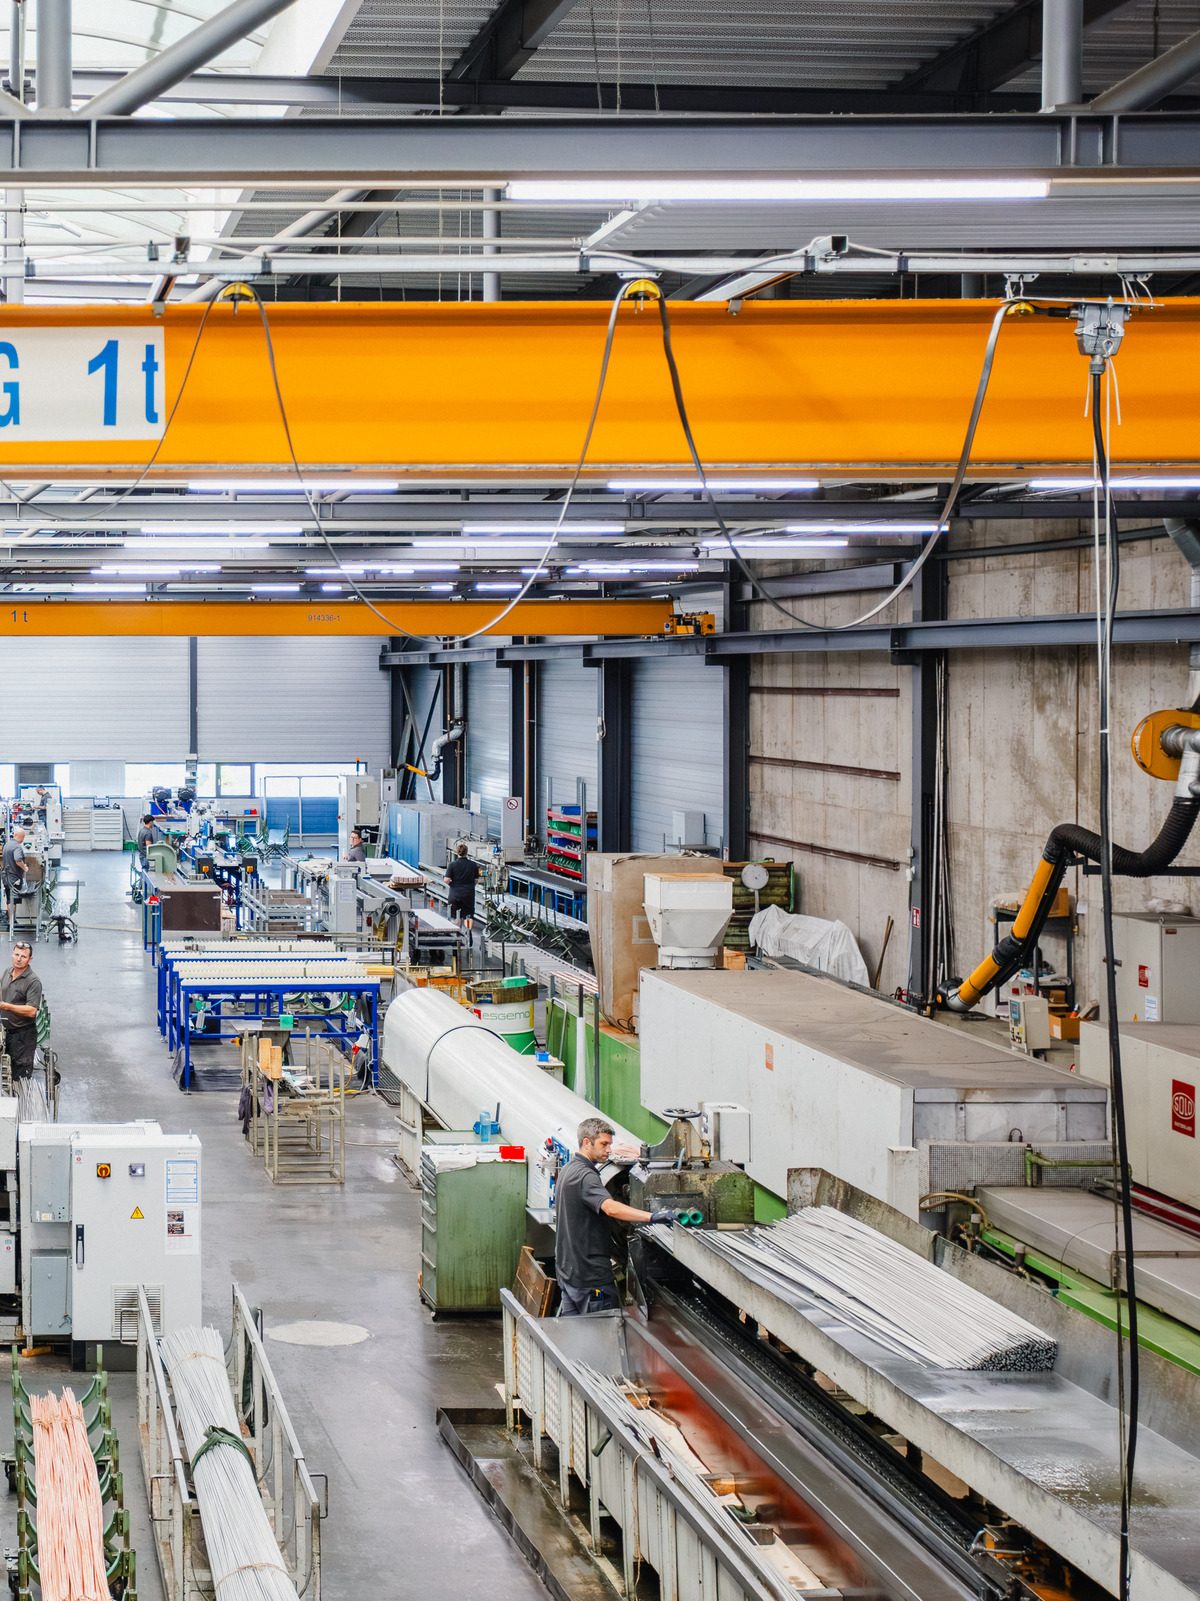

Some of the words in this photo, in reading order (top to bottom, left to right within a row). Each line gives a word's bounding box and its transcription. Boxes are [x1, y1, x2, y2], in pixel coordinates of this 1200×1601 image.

[88, 340, 119, 426] 1
[142, 344, 159, 424] t
[10, 610, 17, 622] 1
[23, 610, 29, 623] t
